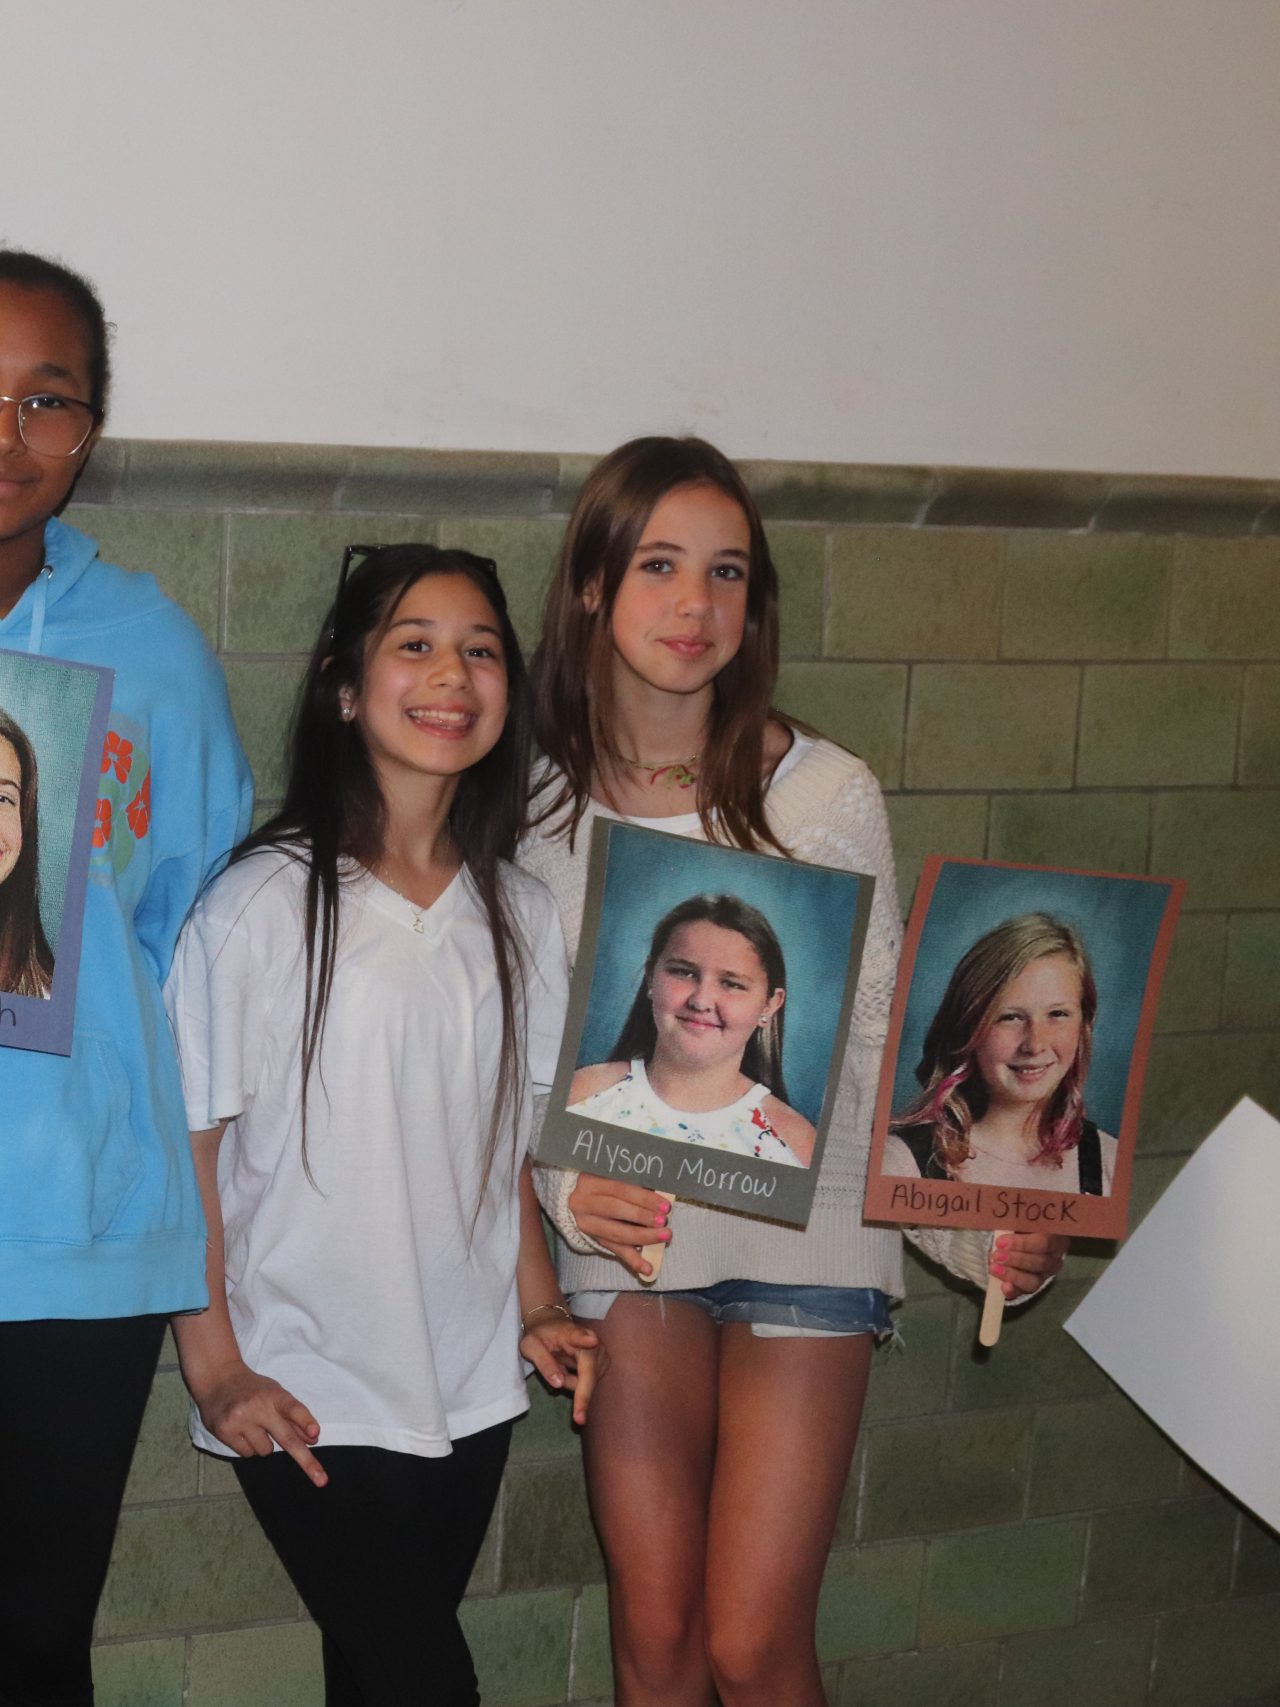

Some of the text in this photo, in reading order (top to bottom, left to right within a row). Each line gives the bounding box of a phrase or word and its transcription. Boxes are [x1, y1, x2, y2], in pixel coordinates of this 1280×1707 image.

[572, 1129, 777, 1198] Alyson Morrow
[891, 1184, 1077, 1223] Abigail Stock
